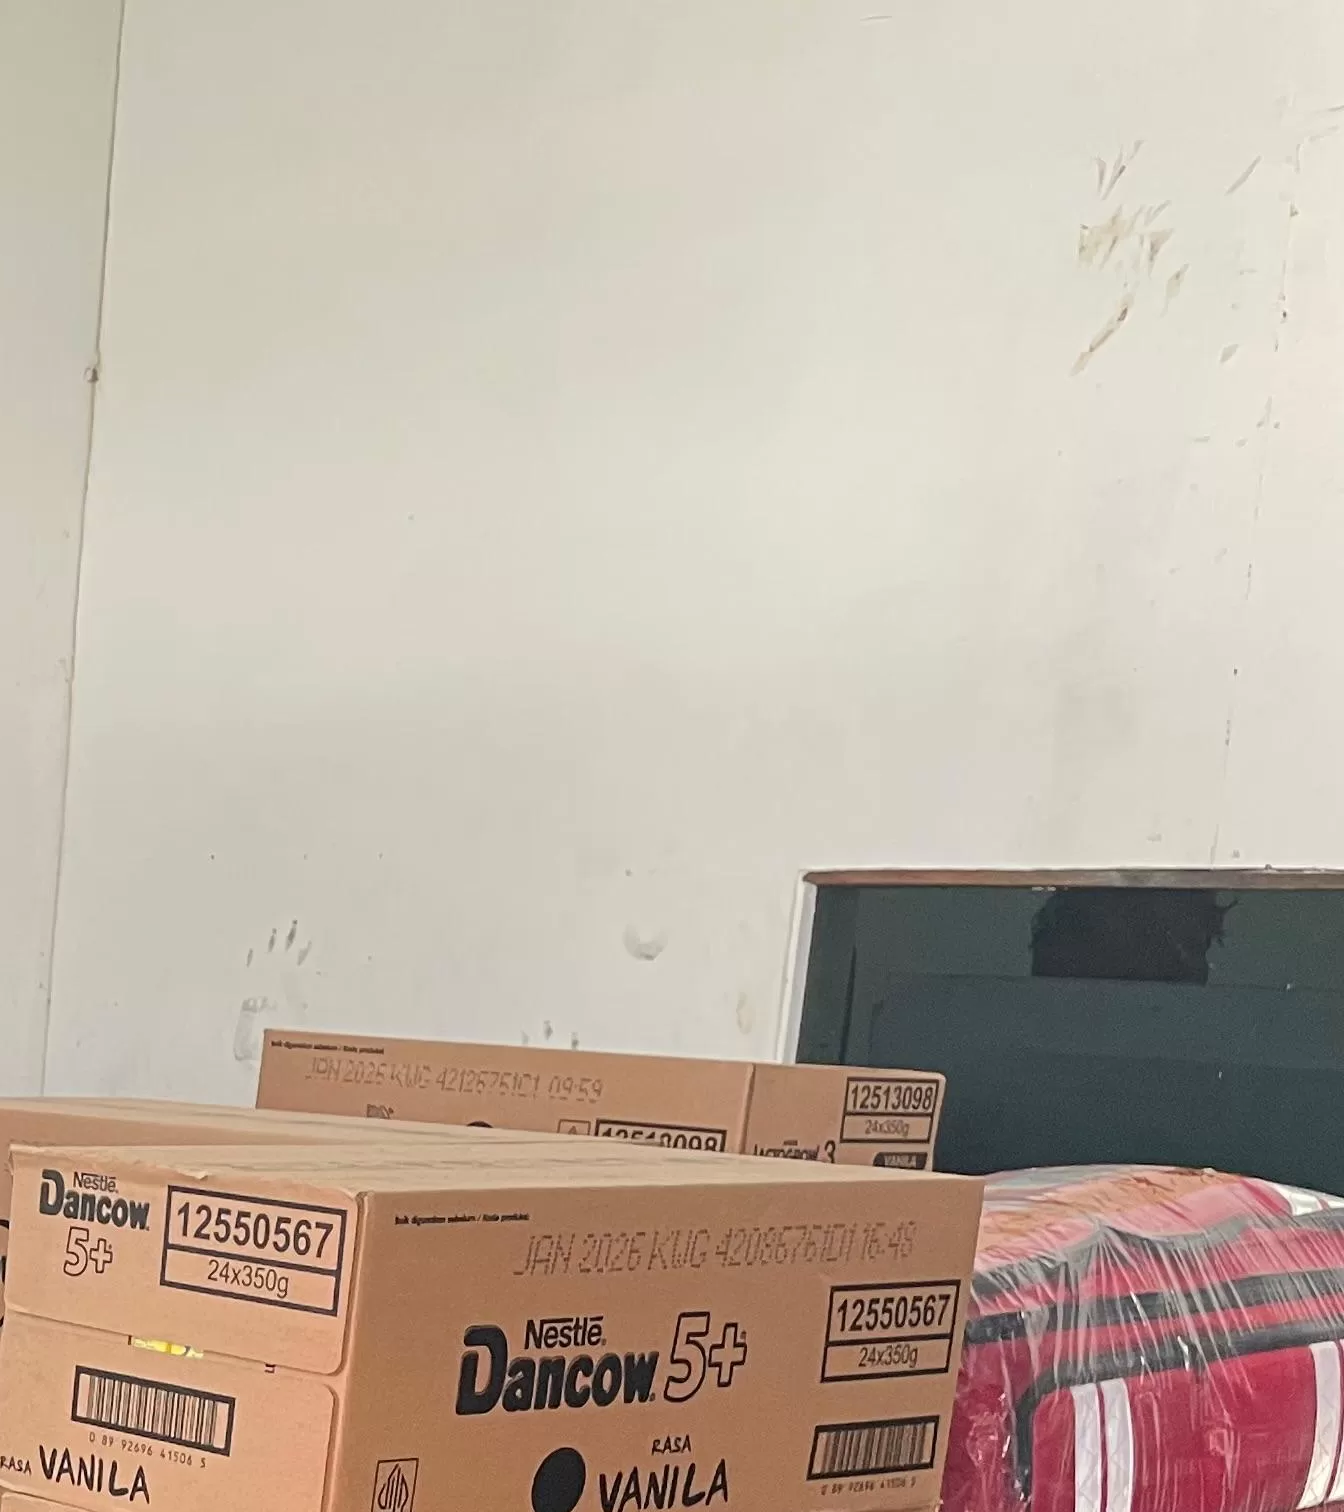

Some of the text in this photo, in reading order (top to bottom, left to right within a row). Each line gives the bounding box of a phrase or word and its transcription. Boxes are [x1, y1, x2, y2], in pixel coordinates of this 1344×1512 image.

[849, 1083, 935, 1112] 12513098
[39, 1168, 150, 1232] Dancow
[176, 1201, 334, 1259] 12550567
[63, 1226, 113, 1277] 5+
[513, 1232, 576, 1277] JAN
[207, 1259, 290, 1299] 24x350g
[836, 1294, 952, 1334] 12550567
[455, 1310, 748, 1417] Dancow 5+
[857, 1343, 920, 1370] 24x350g
[0, 1454, 33, 1476] RASA
[651, 1434, 692, 1457] RASA
[38, 1443, 151, 1505] VANILA
